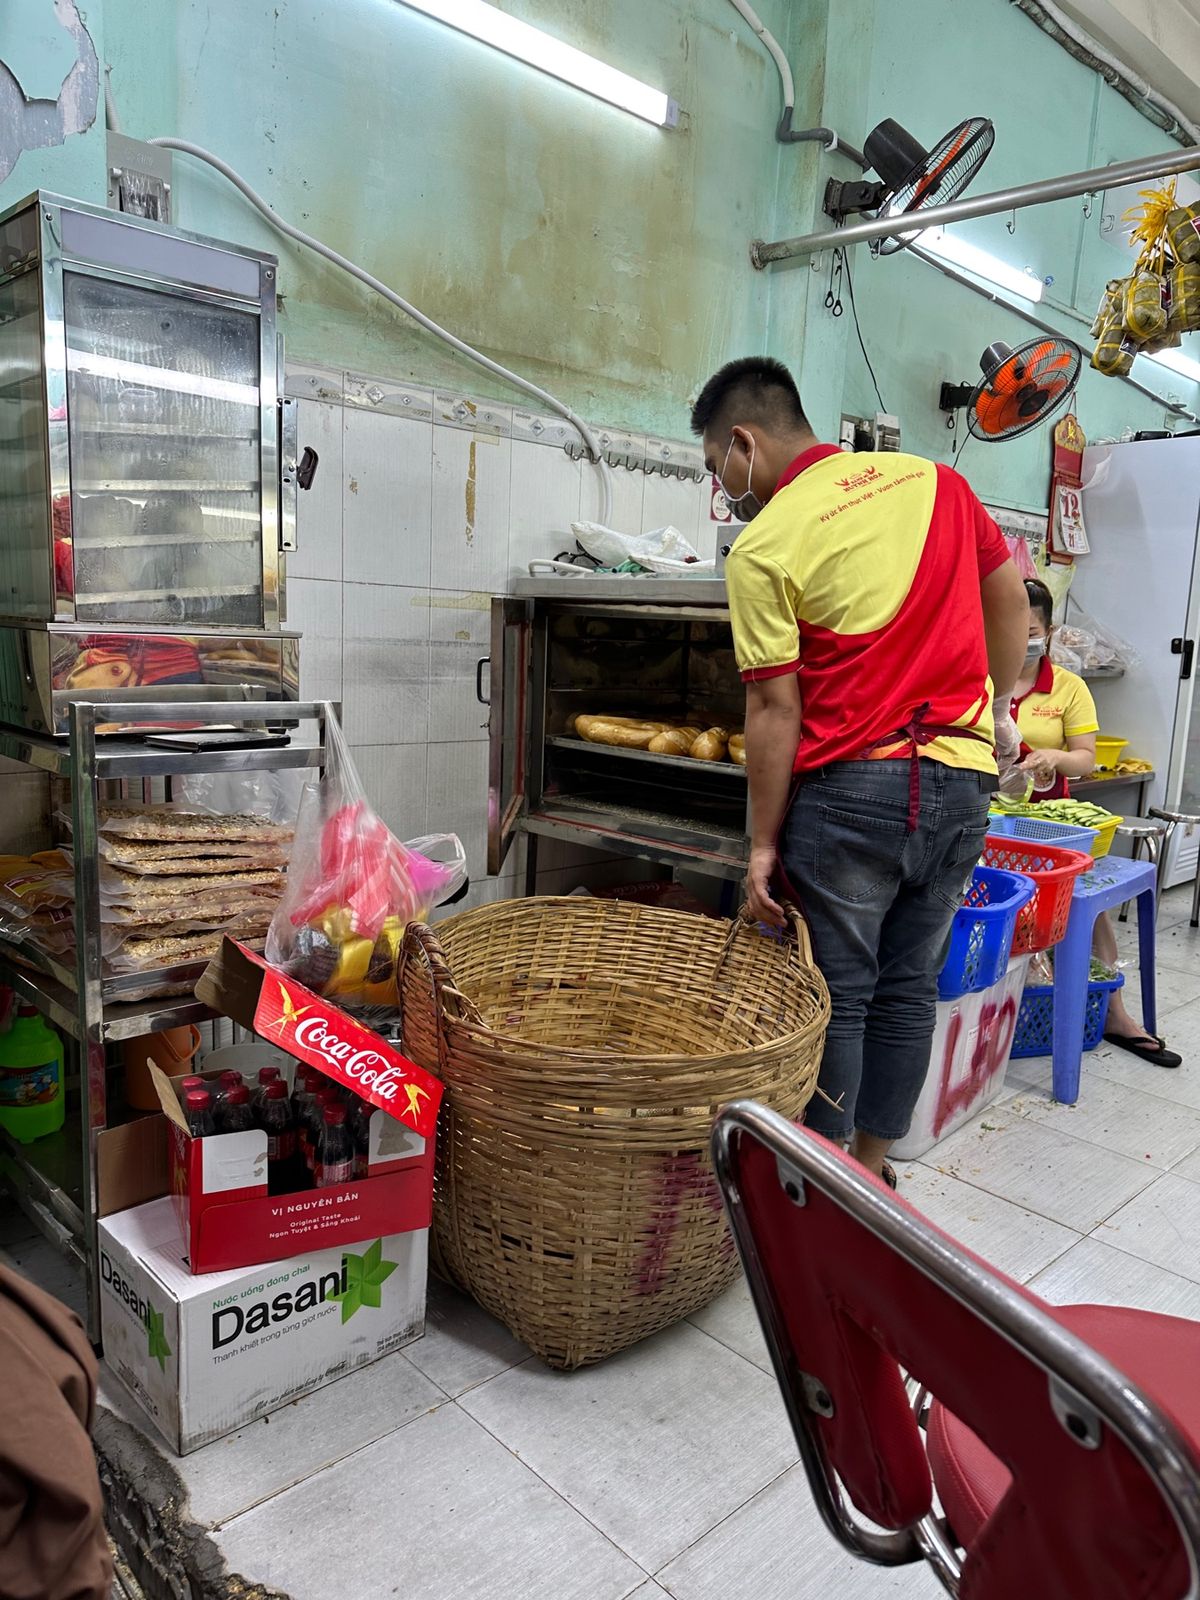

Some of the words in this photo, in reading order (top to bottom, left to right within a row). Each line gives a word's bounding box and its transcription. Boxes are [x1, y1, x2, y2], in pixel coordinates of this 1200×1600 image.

[295, 1017, 407, 1100] Coca-Cola
[287, 1198, 333, 1213] NGUYÊN
[336, 1192, 359, 1204] BẢN
[290, 1217, 320, 1228] Original
[321, 1213, 342, 1221] Taste
[269, 1231, 289, 1239] Ngon
[101, 1251, 150, 1328] Dasani
[212, 1294, 238, 1310] Nước
[241, 1284, 265, 1298] uống
[291, 1264, 311, 1278] chai
[212, 1257, 348, 1350] Dasani
[213, 1349, 239, 1365] Thanh
[260, 1331, 281, 1345] trong
[282, 1321, 301, 1335] từng
